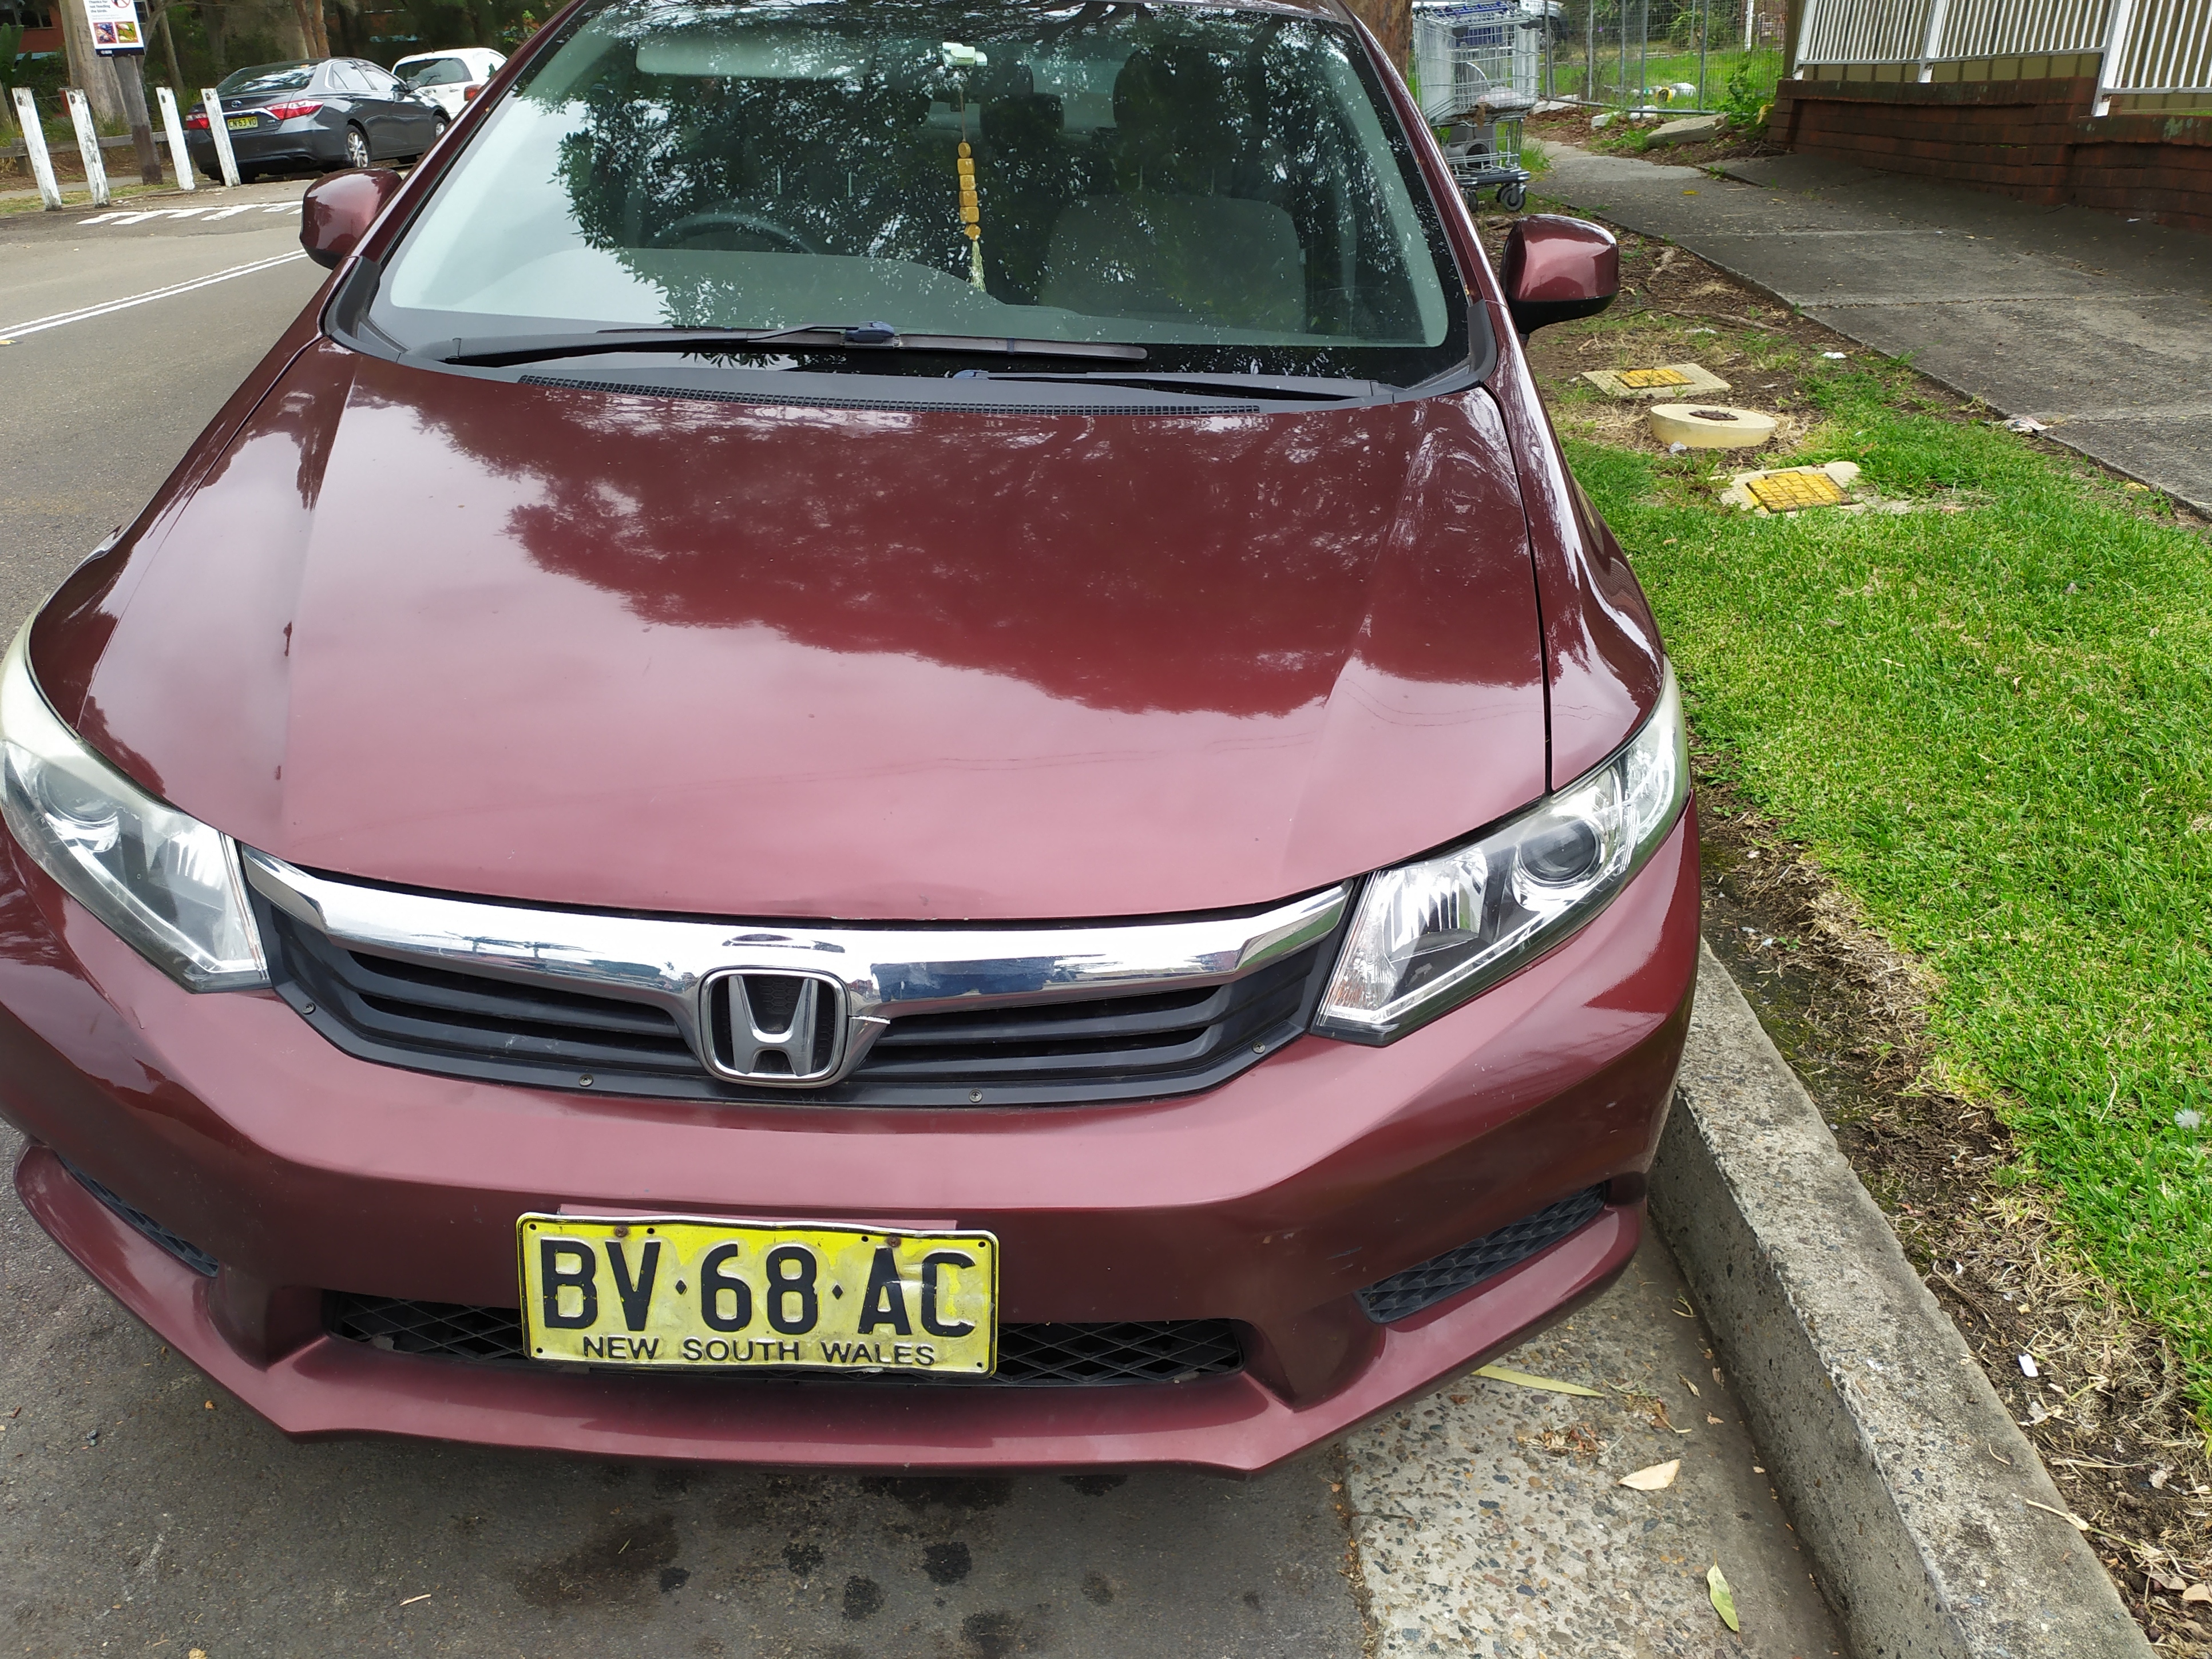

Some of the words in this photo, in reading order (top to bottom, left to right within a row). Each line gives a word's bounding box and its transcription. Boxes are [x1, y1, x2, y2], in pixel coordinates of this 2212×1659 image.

[583, 1335, 659, 1360] NEW
[683, 1336, 800, 1362] SOUTH
[821, 1341, 935, 1366] WALES
